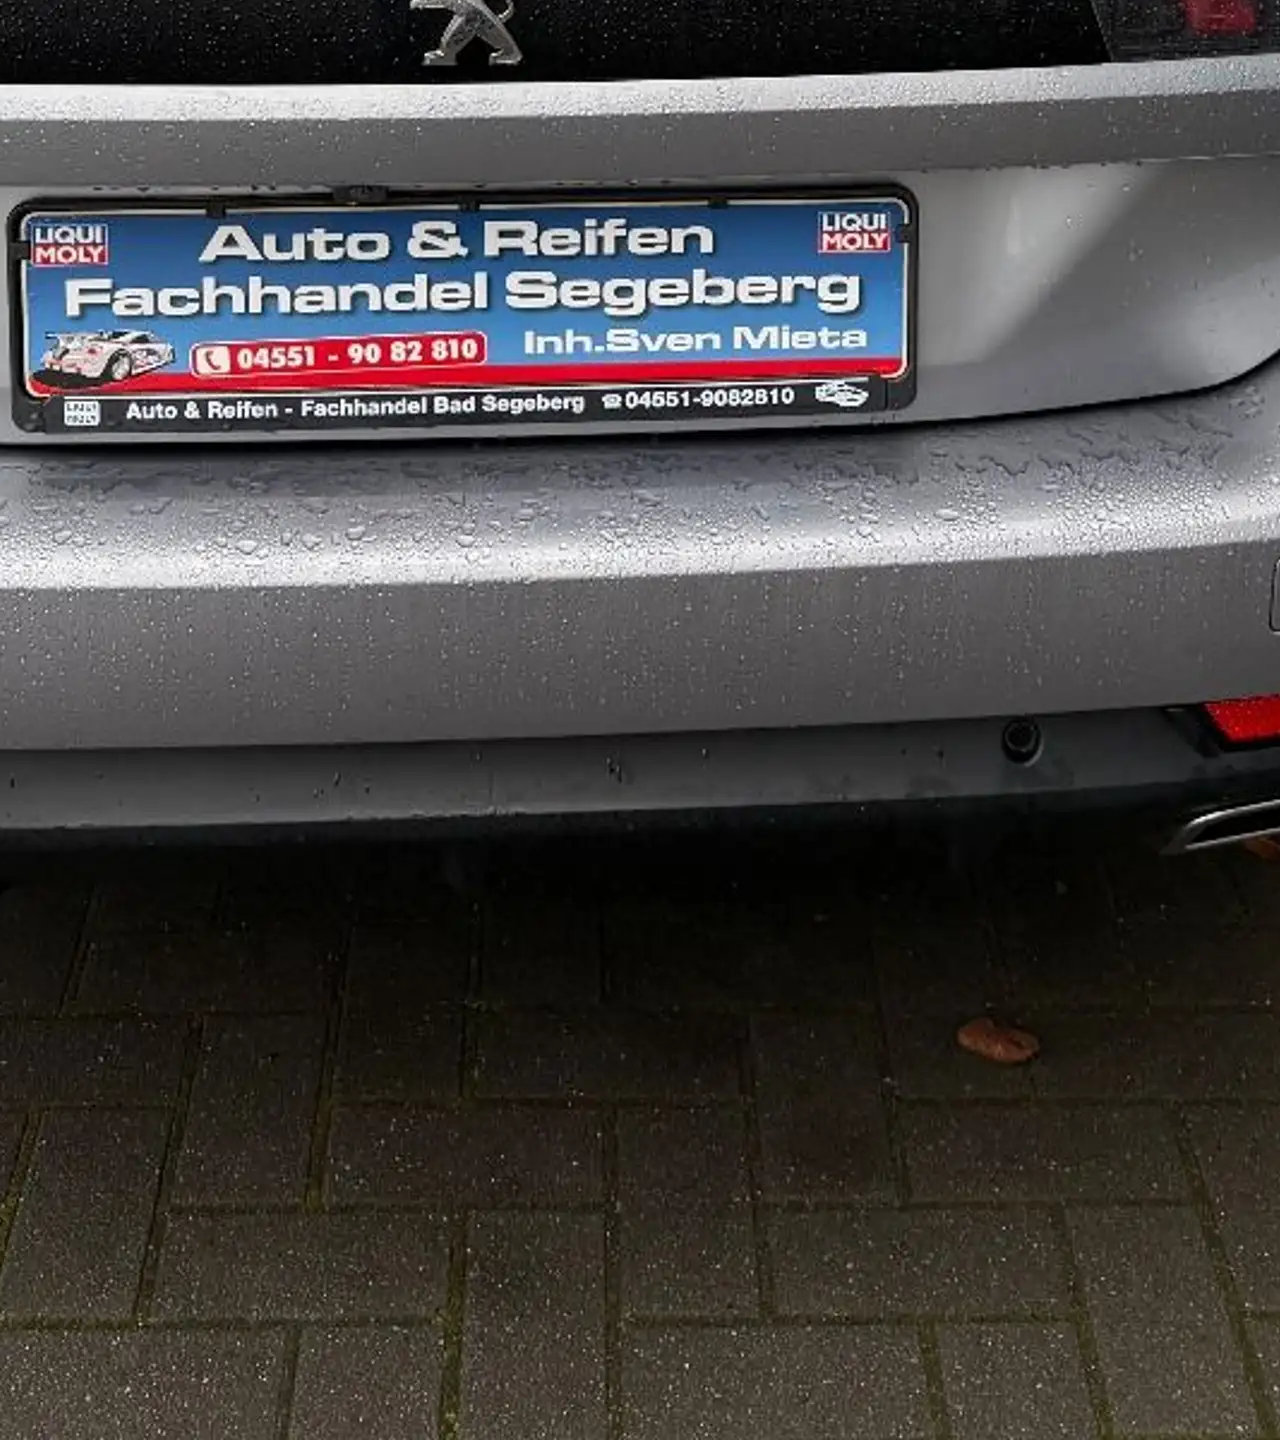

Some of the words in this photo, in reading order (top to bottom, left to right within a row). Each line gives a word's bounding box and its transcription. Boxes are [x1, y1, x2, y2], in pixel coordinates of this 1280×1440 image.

[821, 212, 887, 232] LIQUI
[35, 226, 104, 245] LIQUI
[200, 224, 392, 263] Auto
[407, 221, 468, 259] &
[483, 217, 714, 257] Reifen
[821, 231, 889, 251] MOLY
[35, 244, 105, 264] MOLY
[64, 271, 489, 318] Fachhandel
[505, 269, 860, 317] Segeberg
[732, 324, 867, 350] Mieta
[237, 346, 315, 369] 04551
[347, 343, 382, 364] 90
[390, 341, 421, 362] 82
[431, 338, 477, 360] 810
[125, 402, 178, 420] Auto
[184, 402, 202, 419] &
[208, 399, 278, 419] Reifen
[301, 396, 427, 417] Fachhandel
[434, 396, 476, 413] Bad
[481, 392, 586, 414] Segeberg
